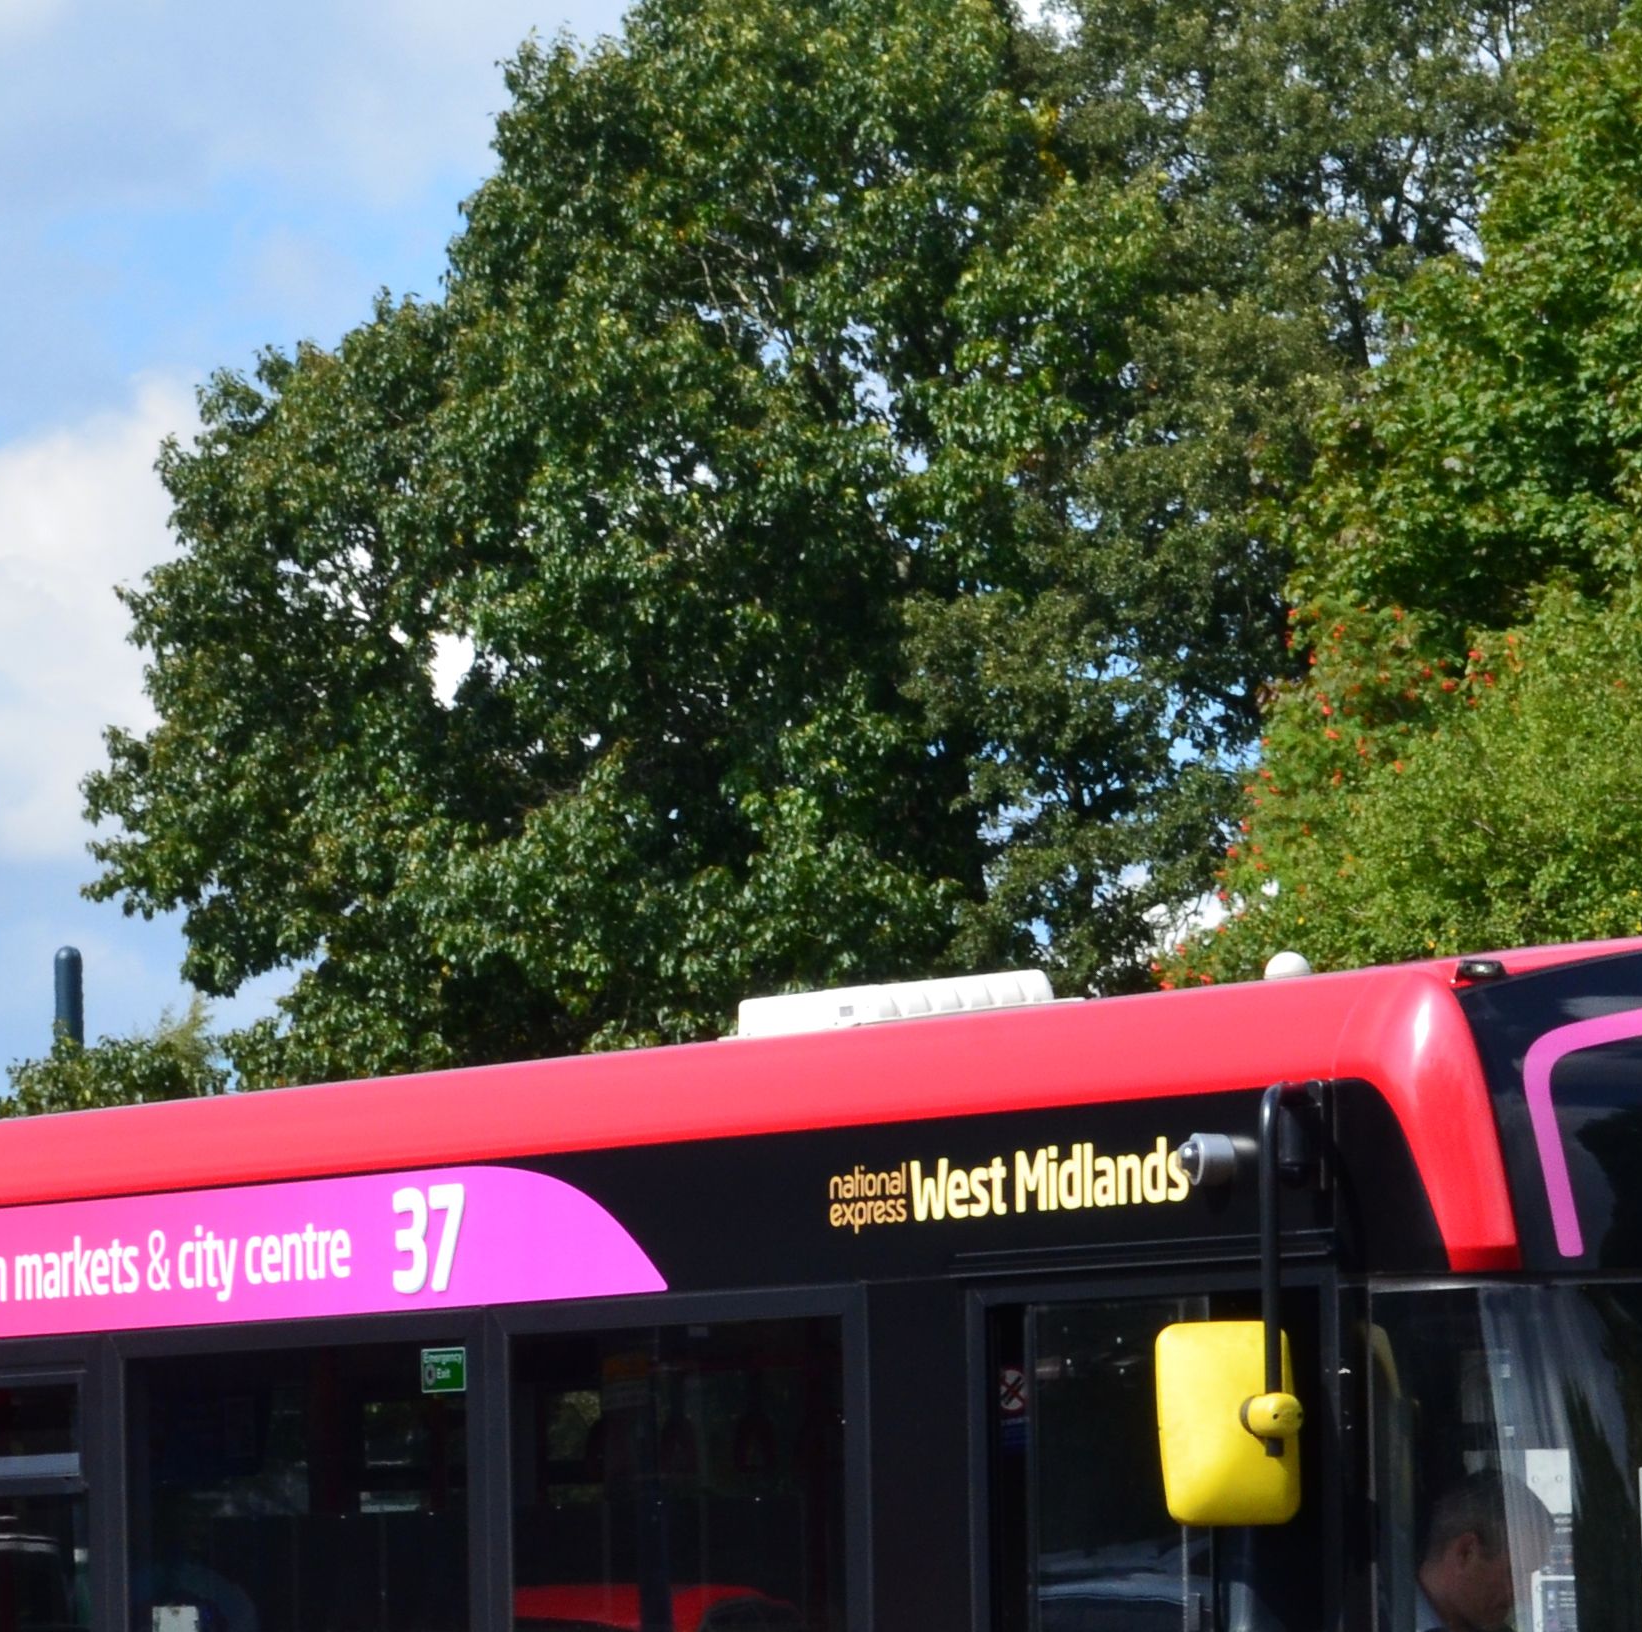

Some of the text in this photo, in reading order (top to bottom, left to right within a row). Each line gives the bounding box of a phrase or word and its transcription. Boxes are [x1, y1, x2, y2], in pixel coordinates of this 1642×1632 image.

[829, 1162, 907, 1199] national
[910, 1135, 1189, 1222] West Midlands
[829, 1198, 908, 1235] express
[391, 1184, 465, 1295] 37
[14, 1236, 140, 1301] markets
[146, 1229, 171, 1292] &
[178, 1225, 238, 1302] city
[244, 1222, 352, 1285] centre
[423, 1351, 462, 1365] Emergency
[436, 1368, 452, 1379] Exit
